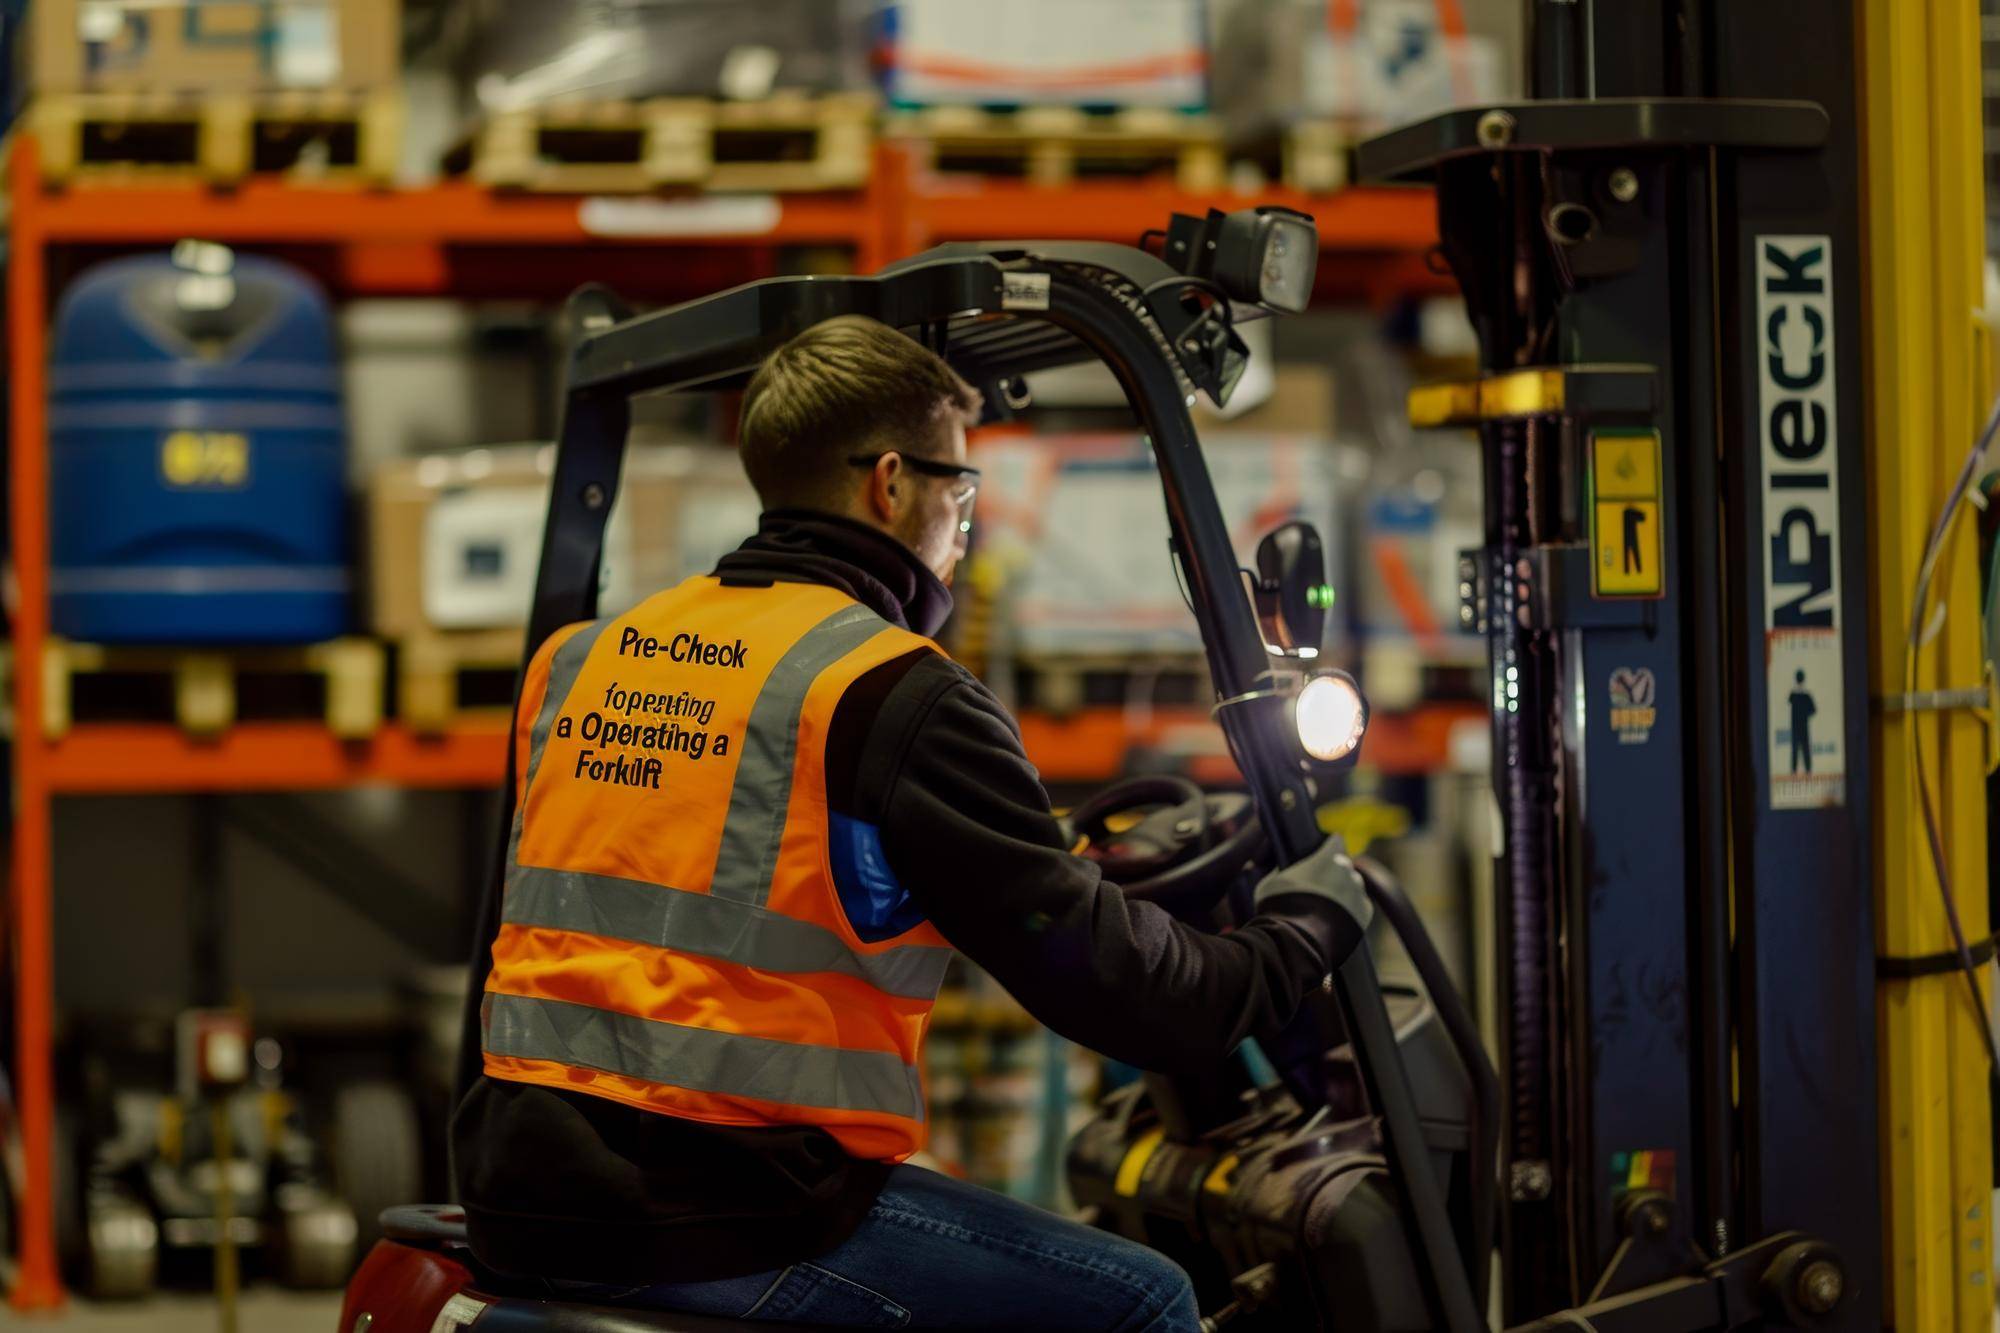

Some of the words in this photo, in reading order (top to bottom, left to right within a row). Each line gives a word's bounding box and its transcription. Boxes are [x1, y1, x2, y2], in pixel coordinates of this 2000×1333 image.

[556, 717, 573, 738] a
[581, 712, 707, 759] Operating
[712, 735, 729, 756] a
